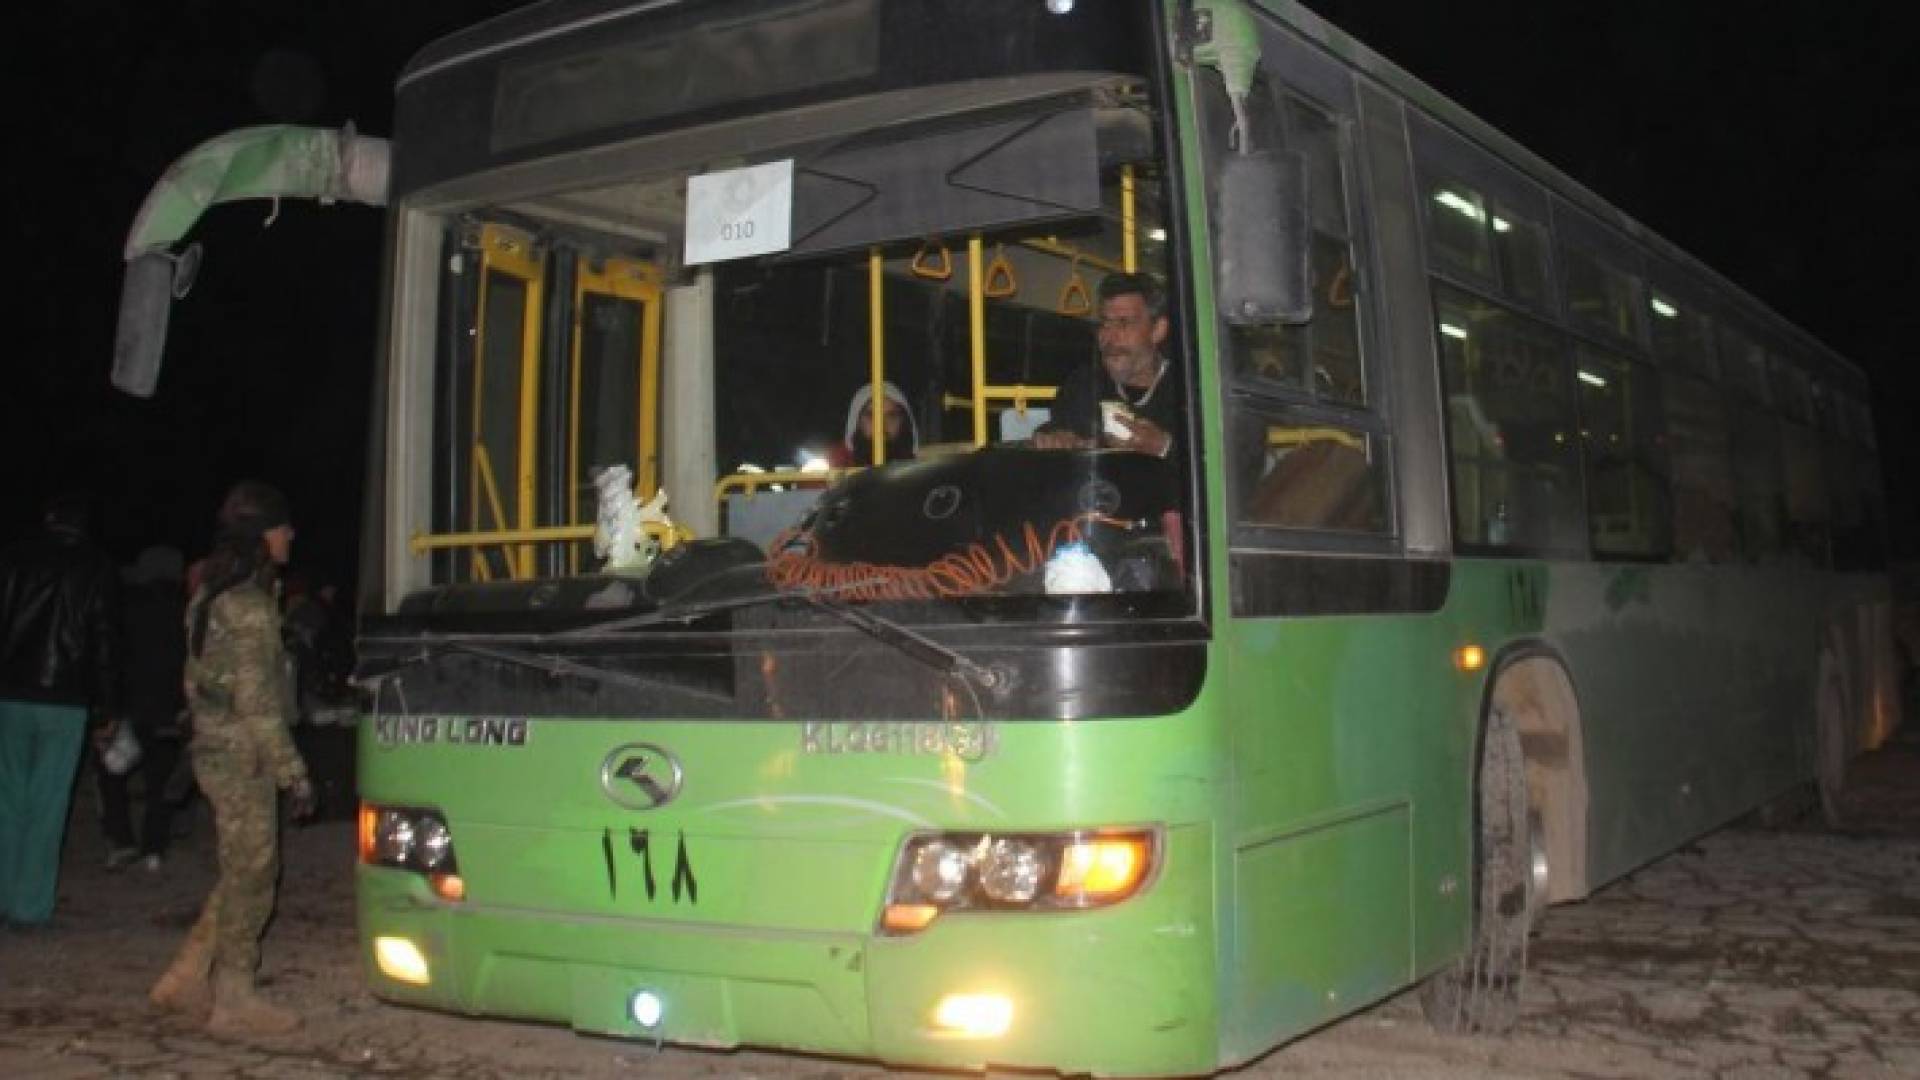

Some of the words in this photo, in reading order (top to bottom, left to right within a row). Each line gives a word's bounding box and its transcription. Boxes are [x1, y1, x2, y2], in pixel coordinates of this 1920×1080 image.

[721, 221, 754, 241] 010
[374, 717, 438, 744] KING
[449, 719, 527, 746] LONG
